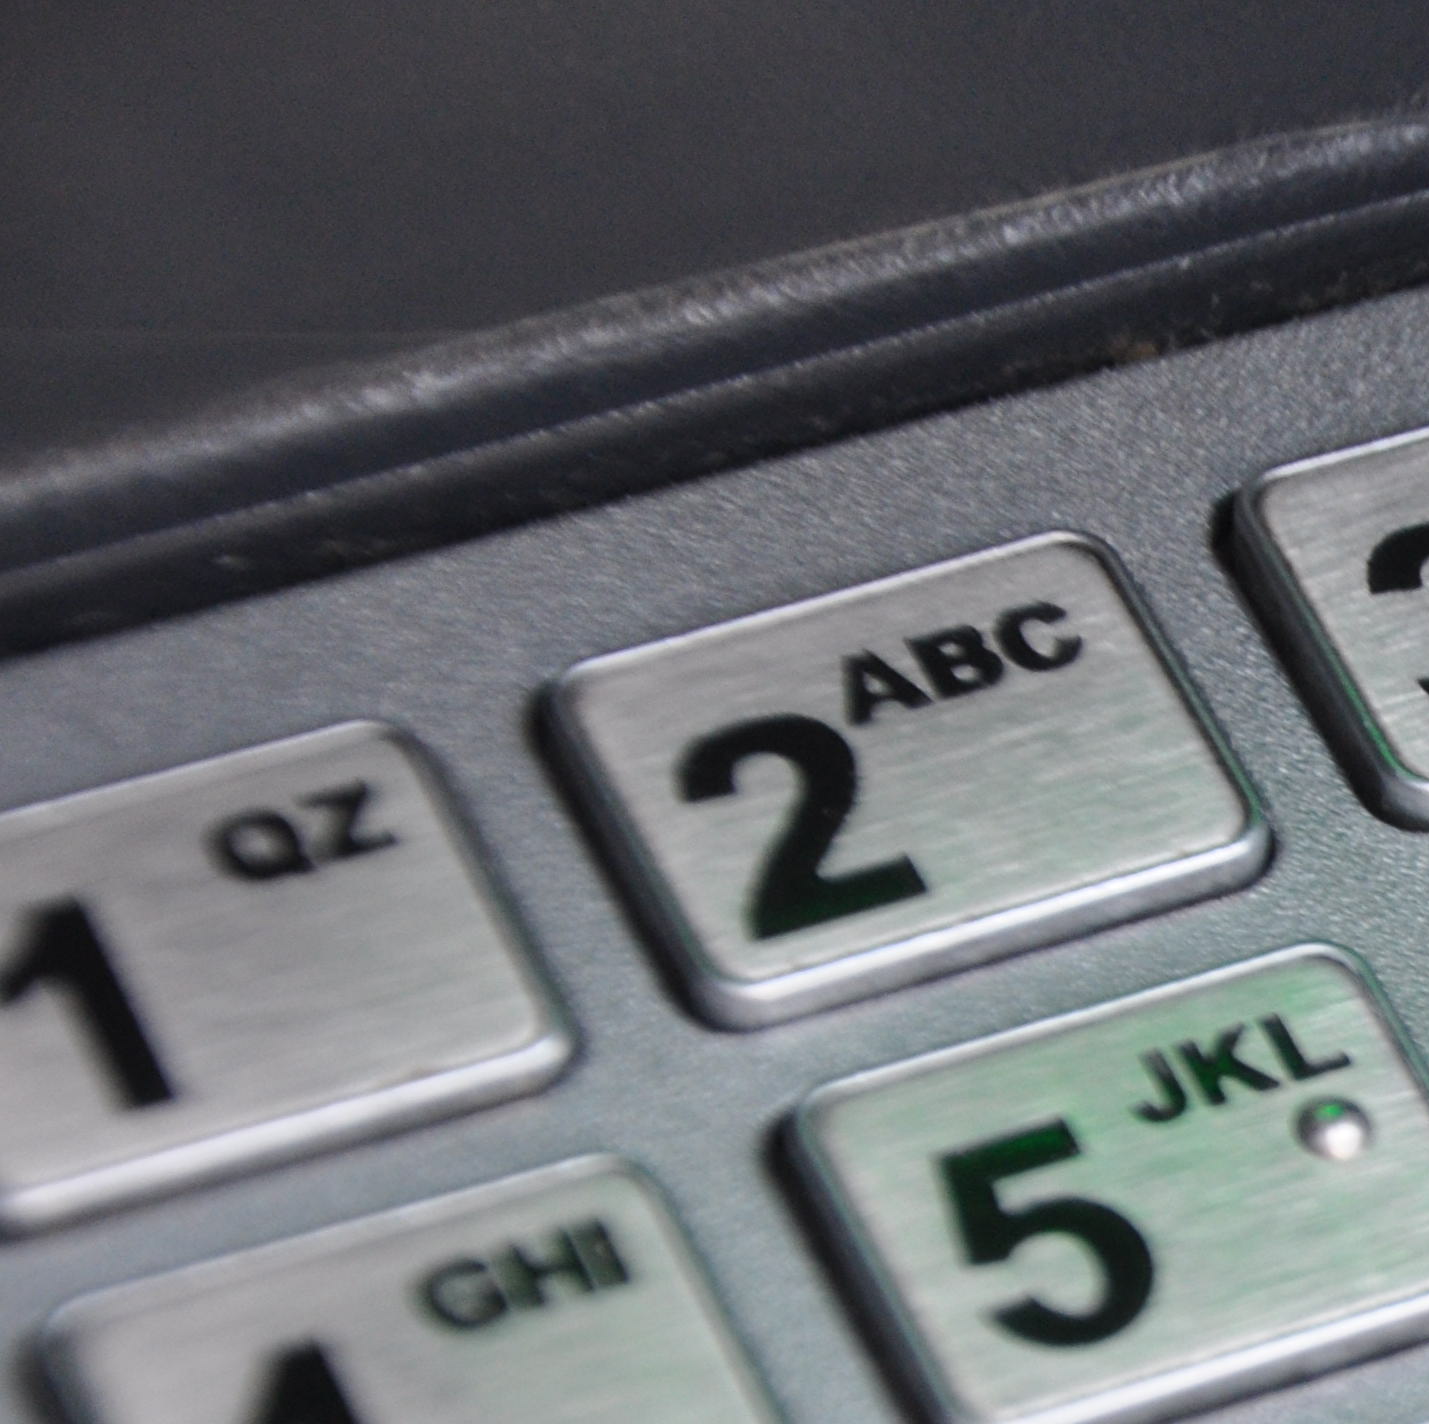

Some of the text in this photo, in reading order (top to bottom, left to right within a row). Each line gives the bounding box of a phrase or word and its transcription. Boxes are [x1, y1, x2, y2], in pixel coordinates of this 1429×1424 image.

[840, 600, 1084, 726] ABC
[208, 780, 396, 884] QZ
[677, 712, 930, 942] 2
[0, 896, 176, 1110] 1
[1132, 1012, 1352, 1126] JKL
[415, 1218, 632, 1334] GHI
[934, 1122, 1156, 1346] 5
